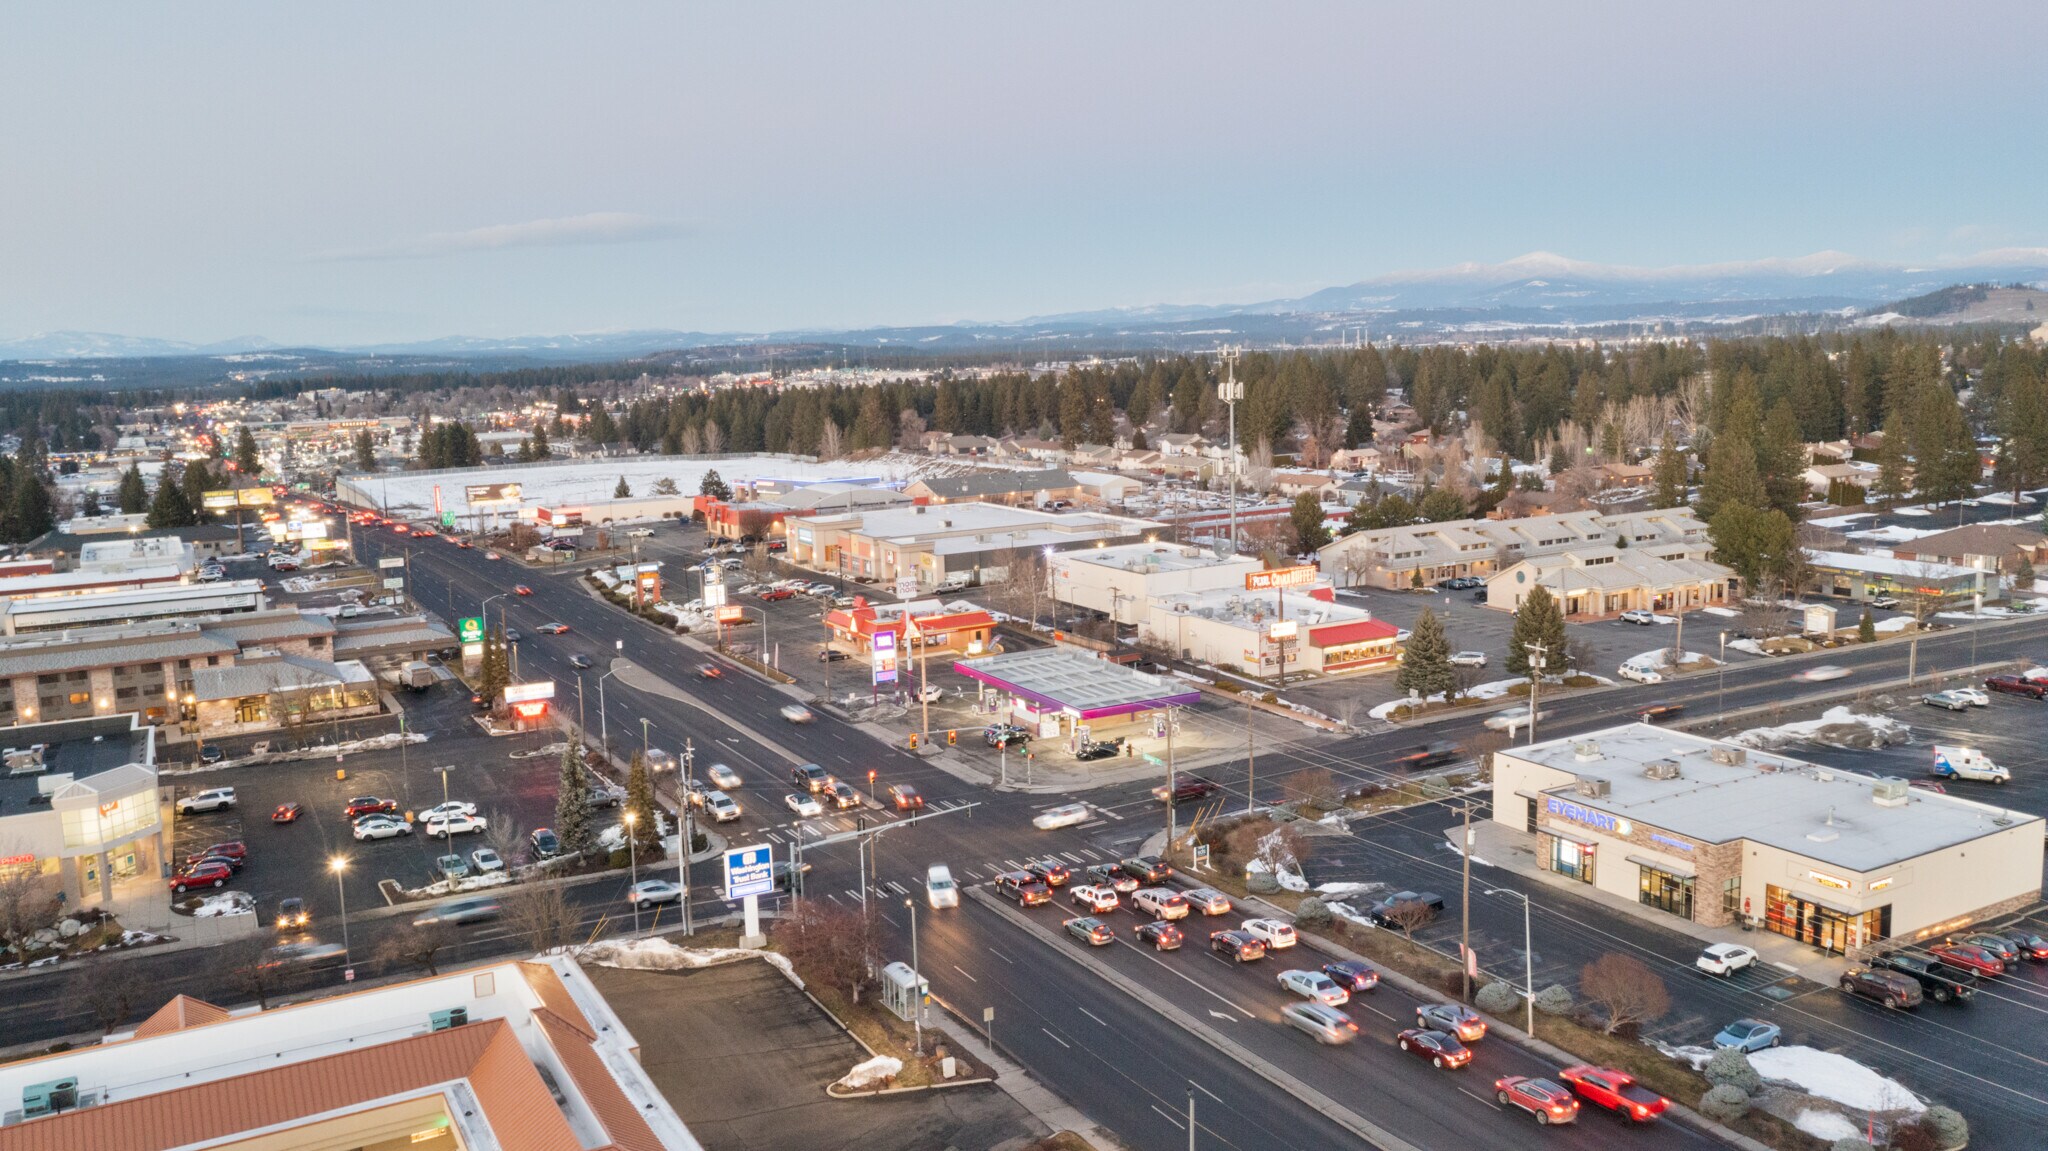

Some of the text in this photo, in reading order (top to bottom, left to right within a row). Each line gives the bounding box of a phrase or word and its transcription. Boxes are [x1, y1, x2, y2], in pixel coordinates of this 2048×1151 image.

[1291, 567, 1314, 585] BUFFET
[1547, 798, 1616, 831] EYEMART
[0, 854, 35, 865] PHOTO
[730, 862, 770, 876] Washington
[733, 870, 769, 884] Trust Bank
